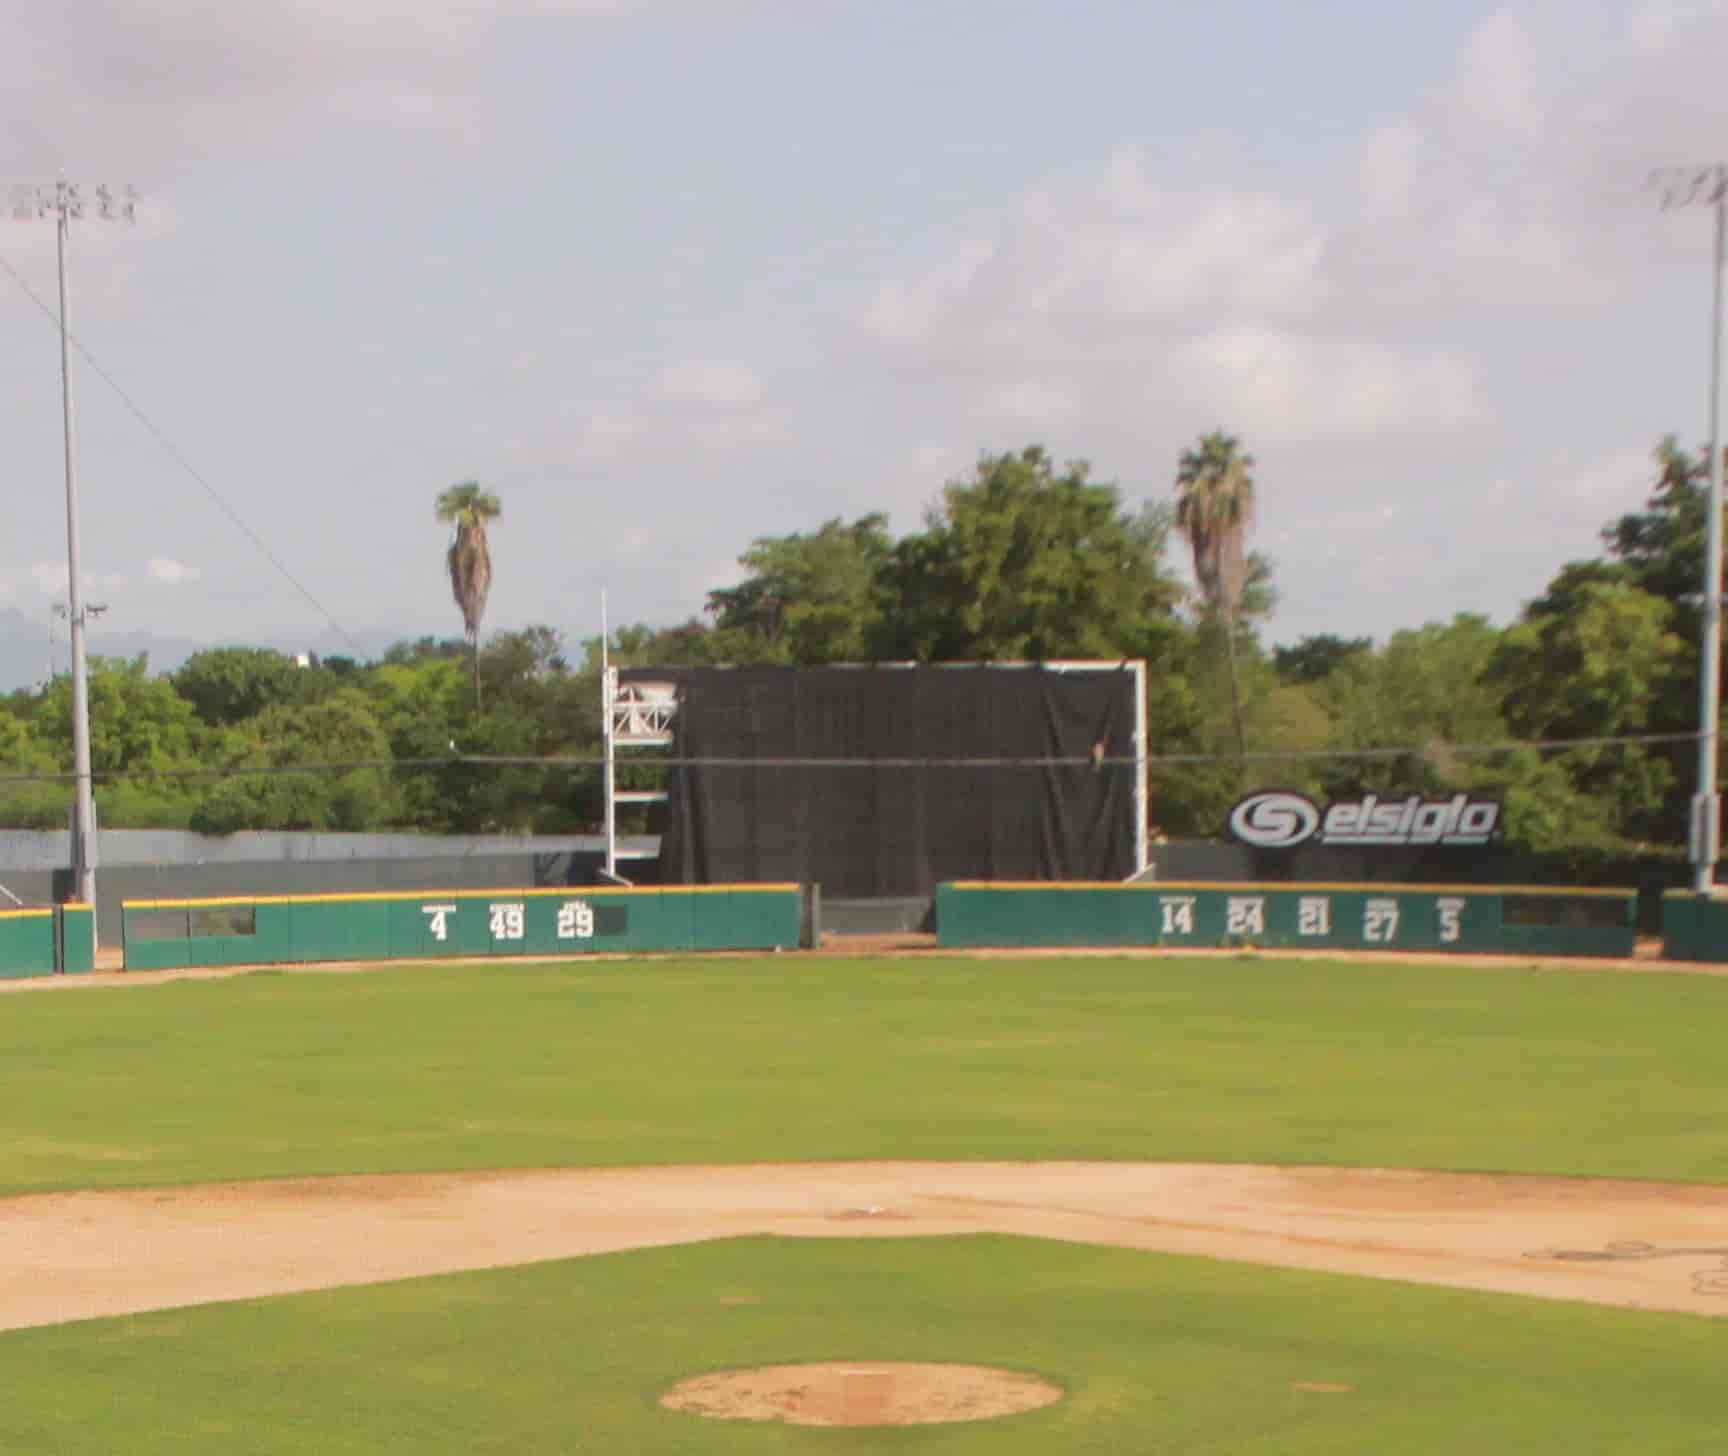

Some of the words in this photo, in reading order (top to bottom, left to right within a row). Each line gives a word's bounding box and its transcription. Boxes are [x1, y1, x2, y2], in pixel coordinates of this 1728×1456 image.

[429, 910, 447, 940] 4
[490, 910, 524, 940] 49
[557, 908, 594, 939] 29
[1161, 903, 1193, 934] 14
[1226, 902, 1264, 934] 24
[1363, 909, 1399, 942] 27
[1440, 910, 1461, 942] 5
